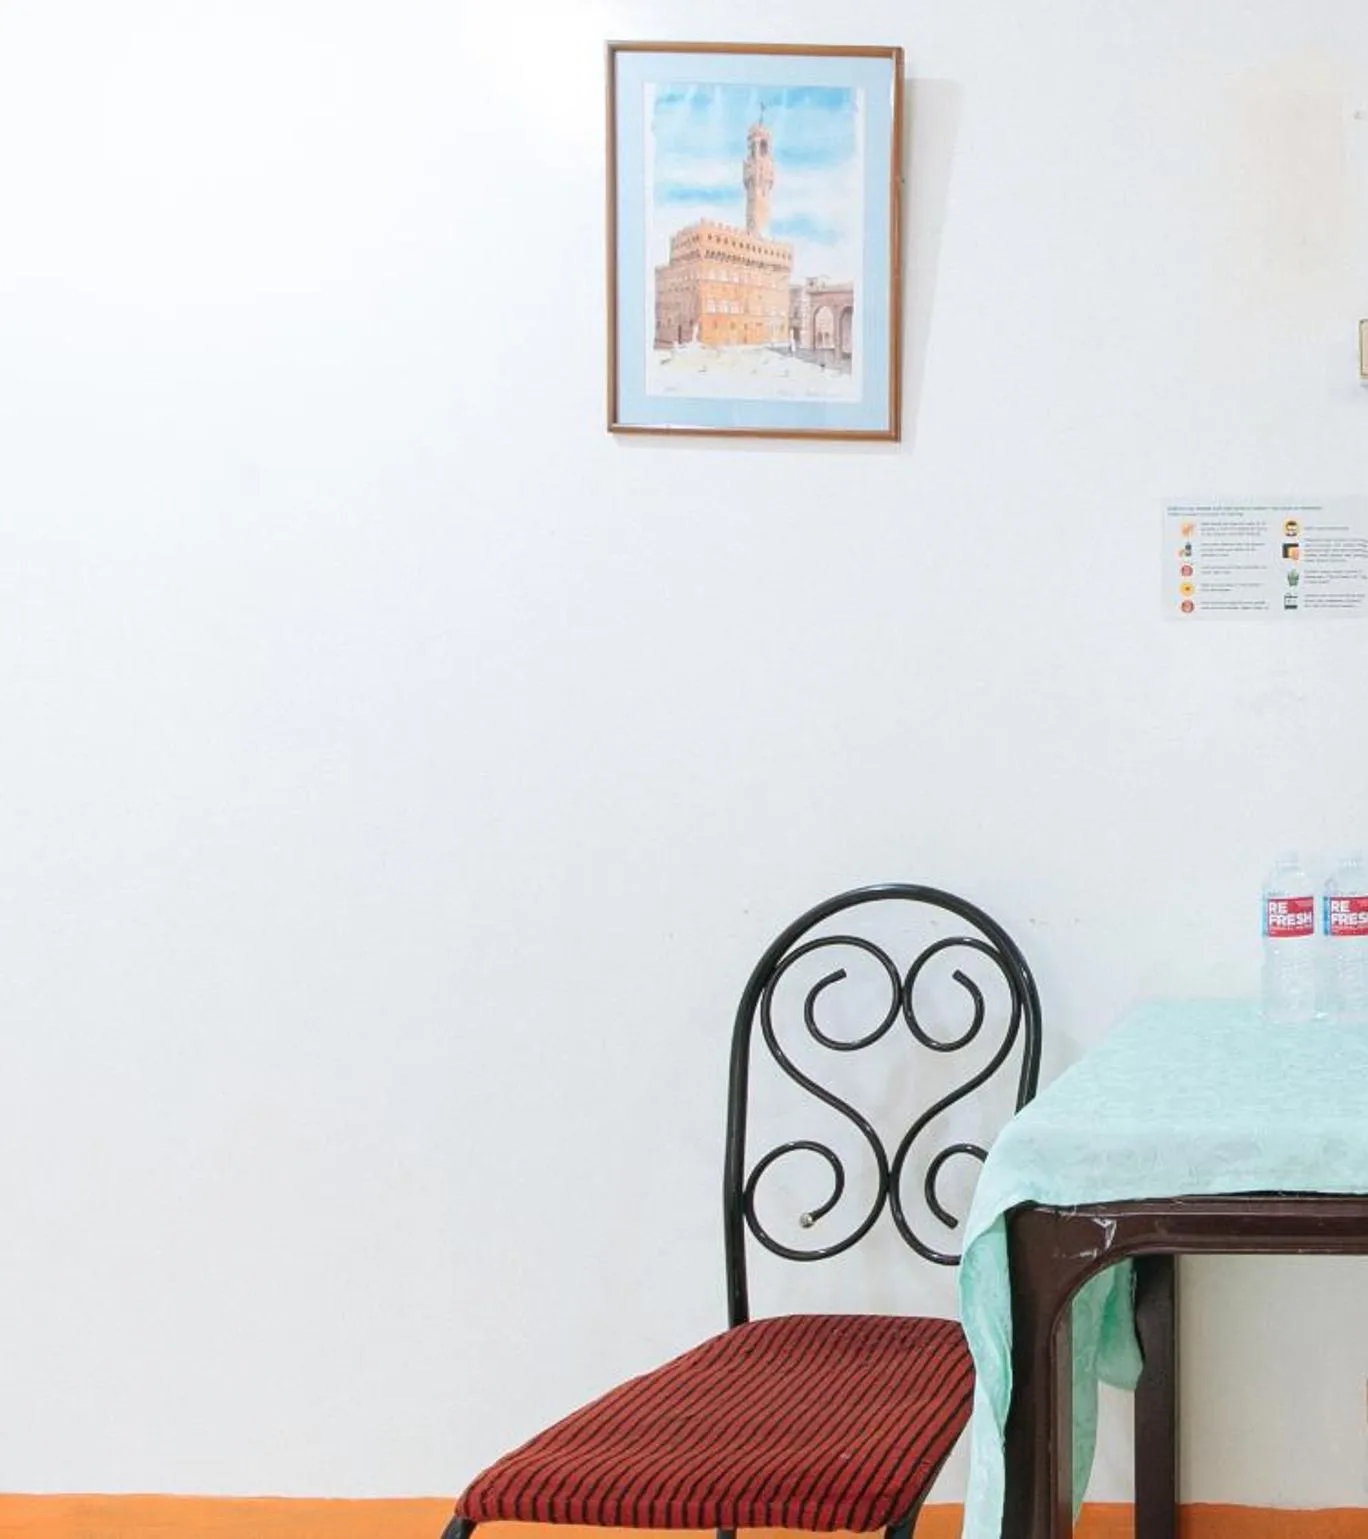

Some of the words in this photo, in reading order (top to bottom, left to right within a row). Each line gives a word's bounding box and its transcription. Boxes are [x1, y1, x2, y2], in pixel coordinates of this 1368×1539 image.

[1269, 901, 1288, 915] RE
[1331, 900, 1350, 913] RE
[1269, 912, 1313, 926] FRESH
